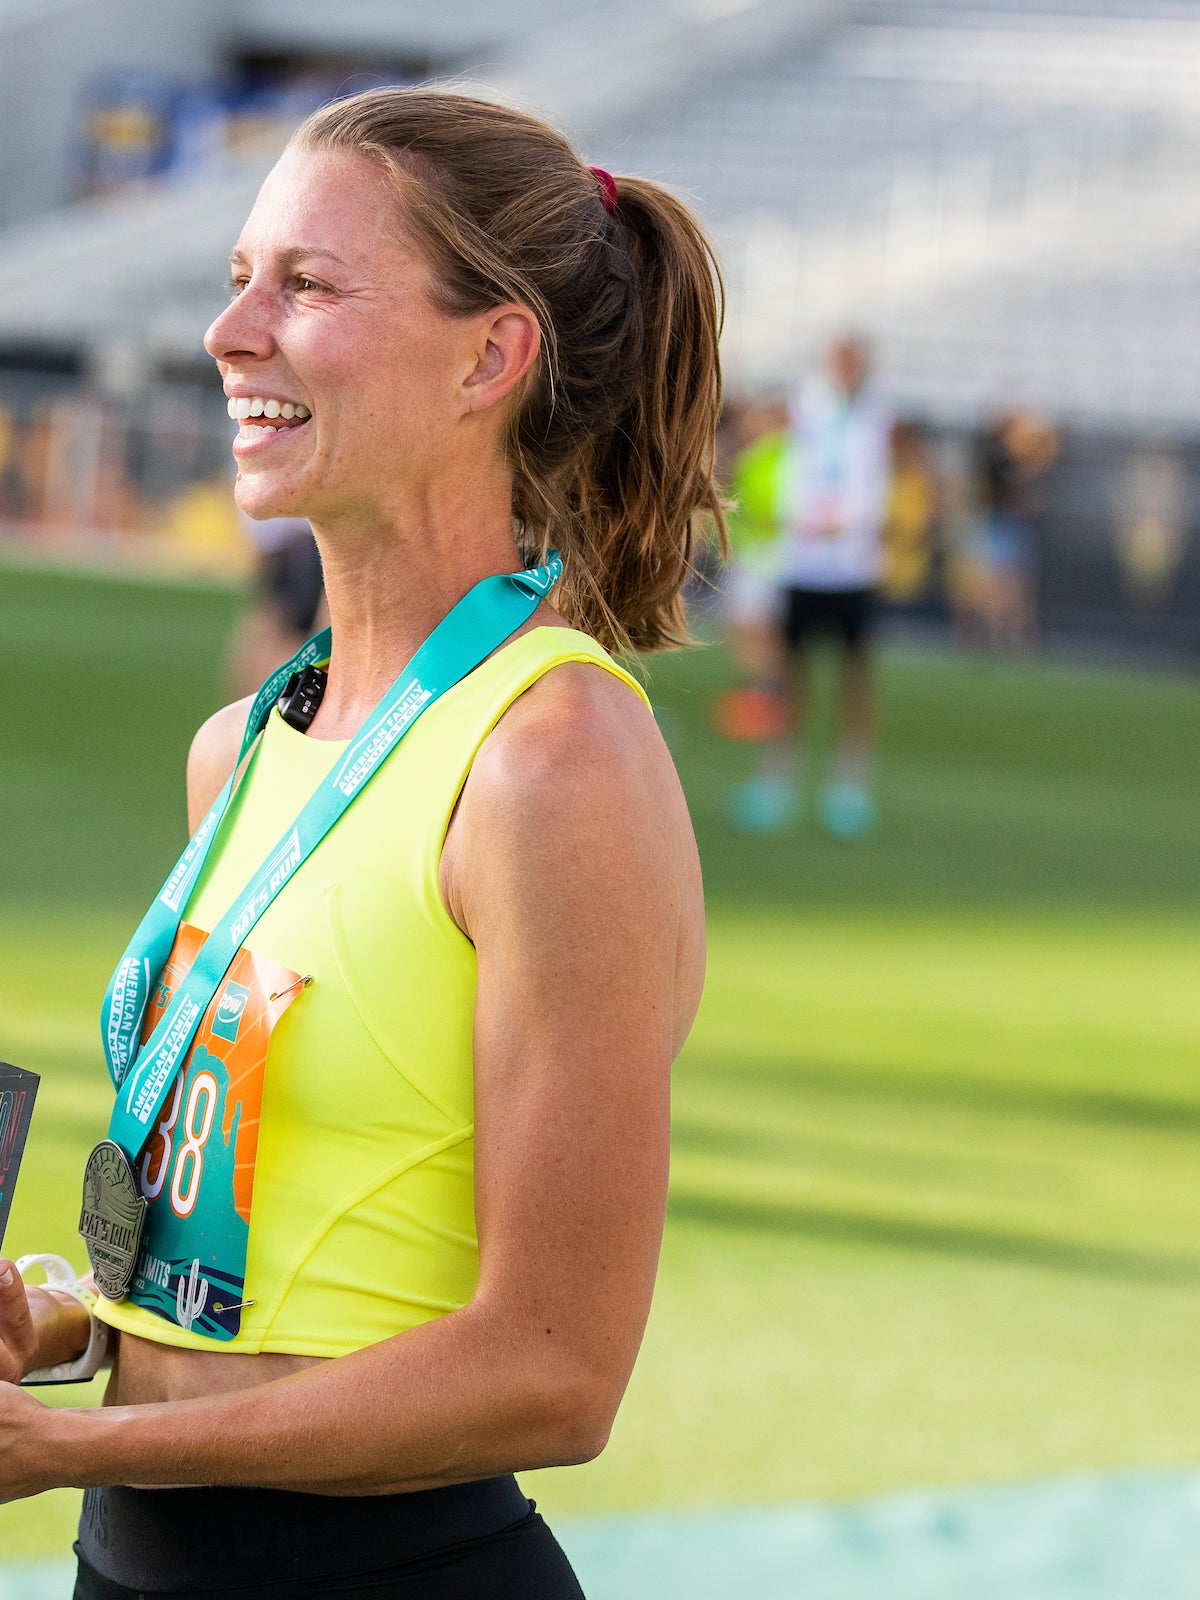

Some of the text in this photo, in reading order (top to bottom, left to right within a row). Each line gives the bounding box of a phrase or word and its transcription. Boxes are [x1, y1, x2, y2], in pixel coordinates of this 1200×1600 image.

[339, 683, 424, 791] AMERICAN FAMILY
[351, 699, 423, 788] INSURANCE
[160, 811, 218, 913] PAT'S RUN
[229, 830, 302, 947] PAT'S RUN
[109, 965, 126, 1071] INSURANCE
[119, 957, 141, 1032] AMERICAN
[132, 1000, 194, 1118] AMERICAN FAMILY
[144, 1014, 195, 1115] INSURANCE
[80, 1210, 137, 1253] PAT'S RUN
